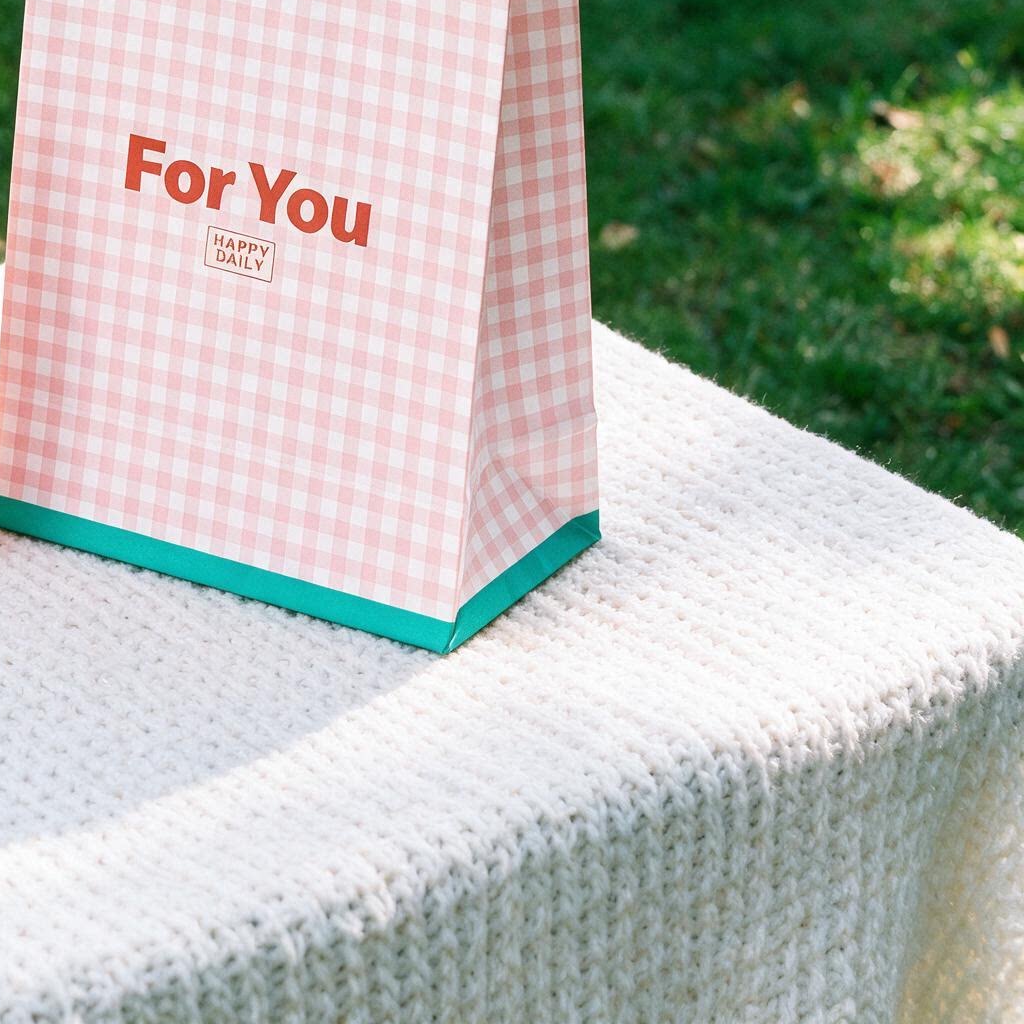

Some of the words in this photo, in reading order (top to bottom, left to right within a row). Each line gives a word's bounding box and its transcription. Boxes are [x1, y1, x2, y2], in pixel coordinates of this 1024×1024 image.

[124, 134, 236, 210] For
[248, 162, 372, 247] You
[214, 234, 270, 258] HAPPY
[216, 249, 265, 272] DAILY
